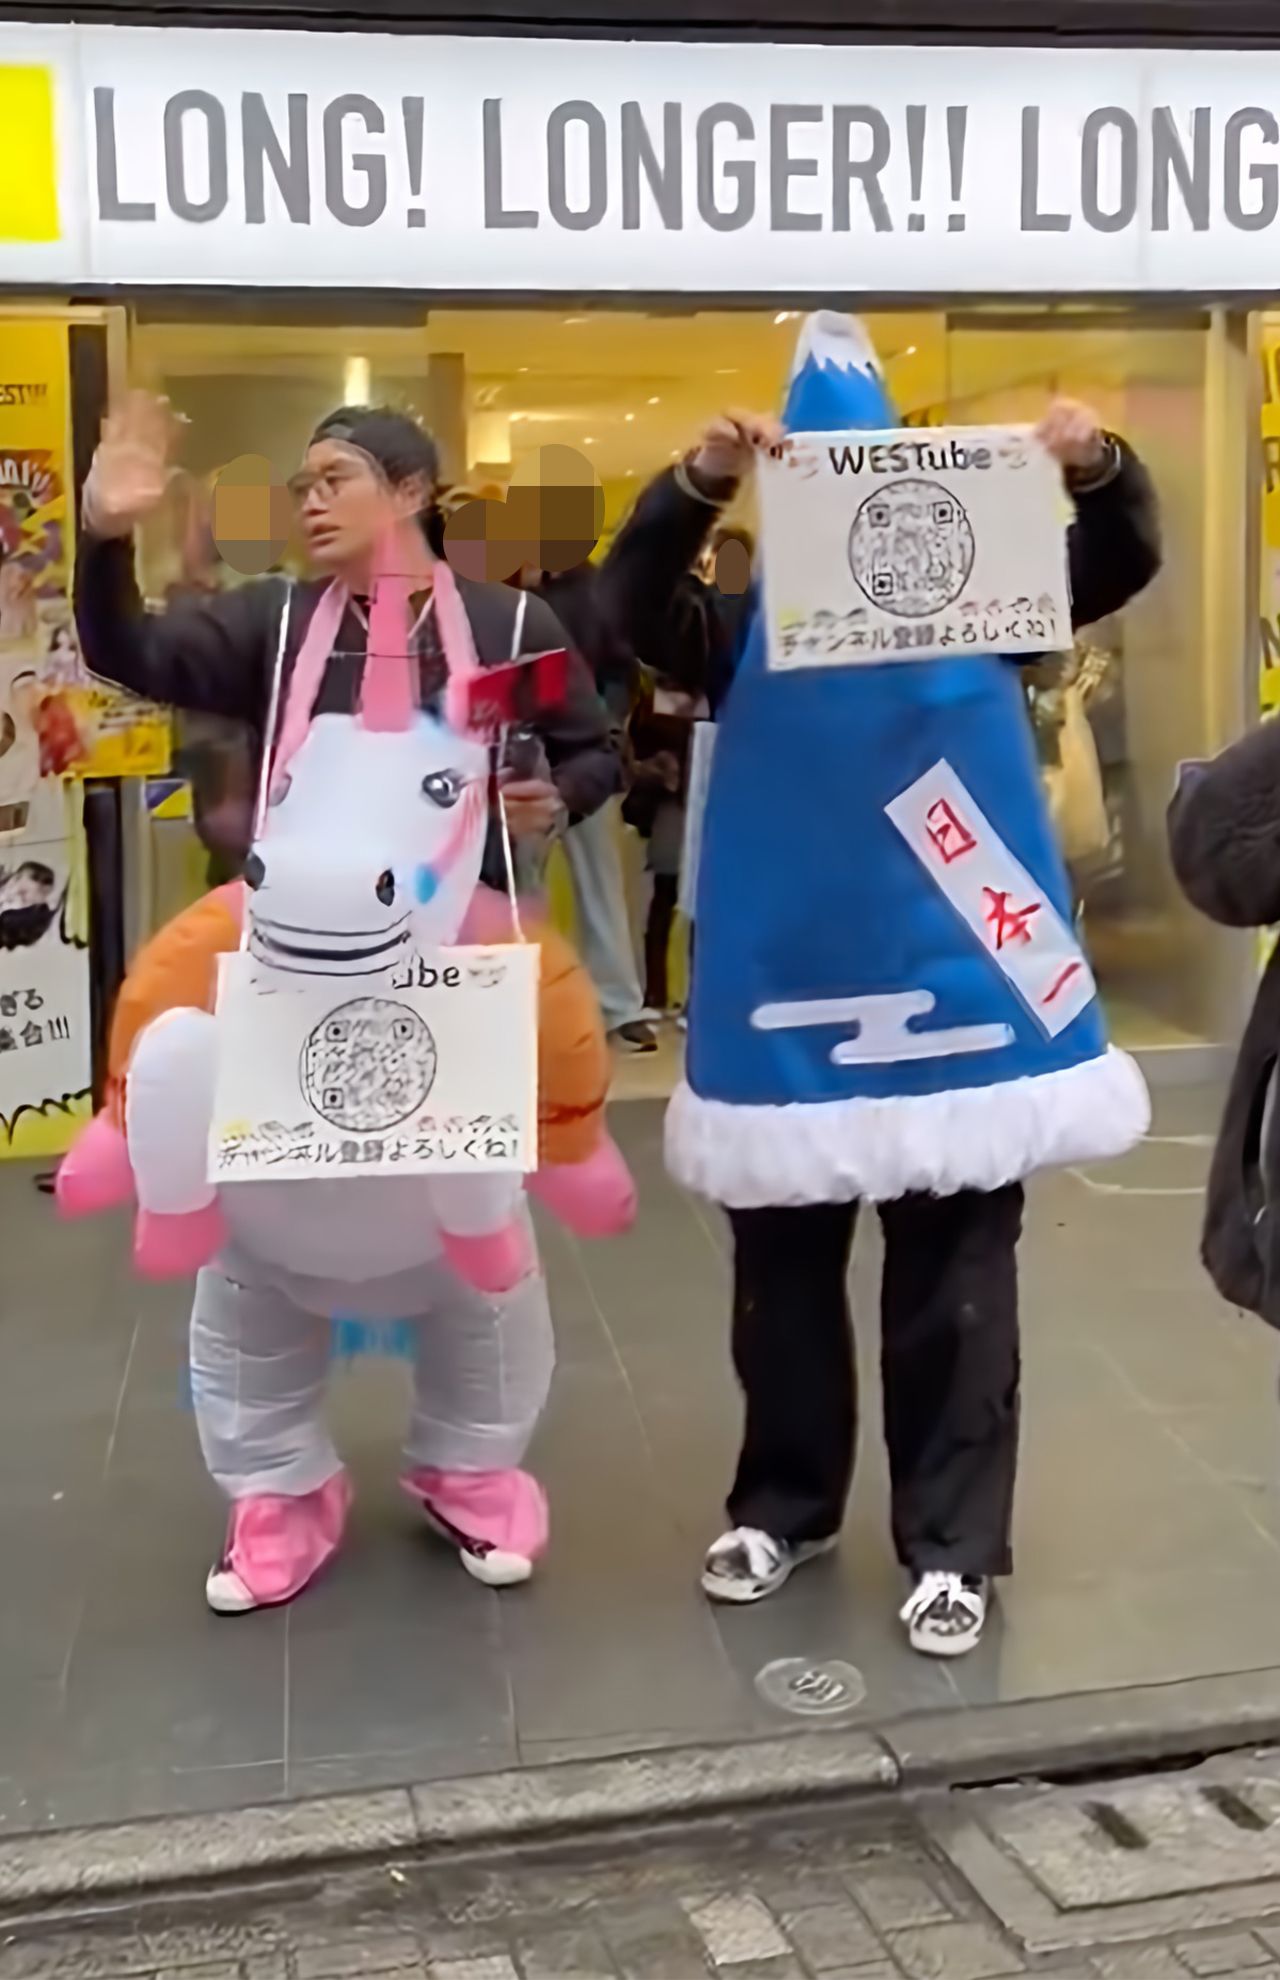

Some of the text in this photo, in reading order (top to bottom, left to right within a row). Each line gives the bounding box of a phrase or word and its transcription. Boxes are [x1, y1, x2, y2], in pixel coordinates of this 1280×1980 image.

[94, 86, 426, 227] LONG!
[482, 97, 968, 233] LONGER!!
[828, 440, 992, 476] WESTube
[925, 798, 1082, 1005] 日本一
